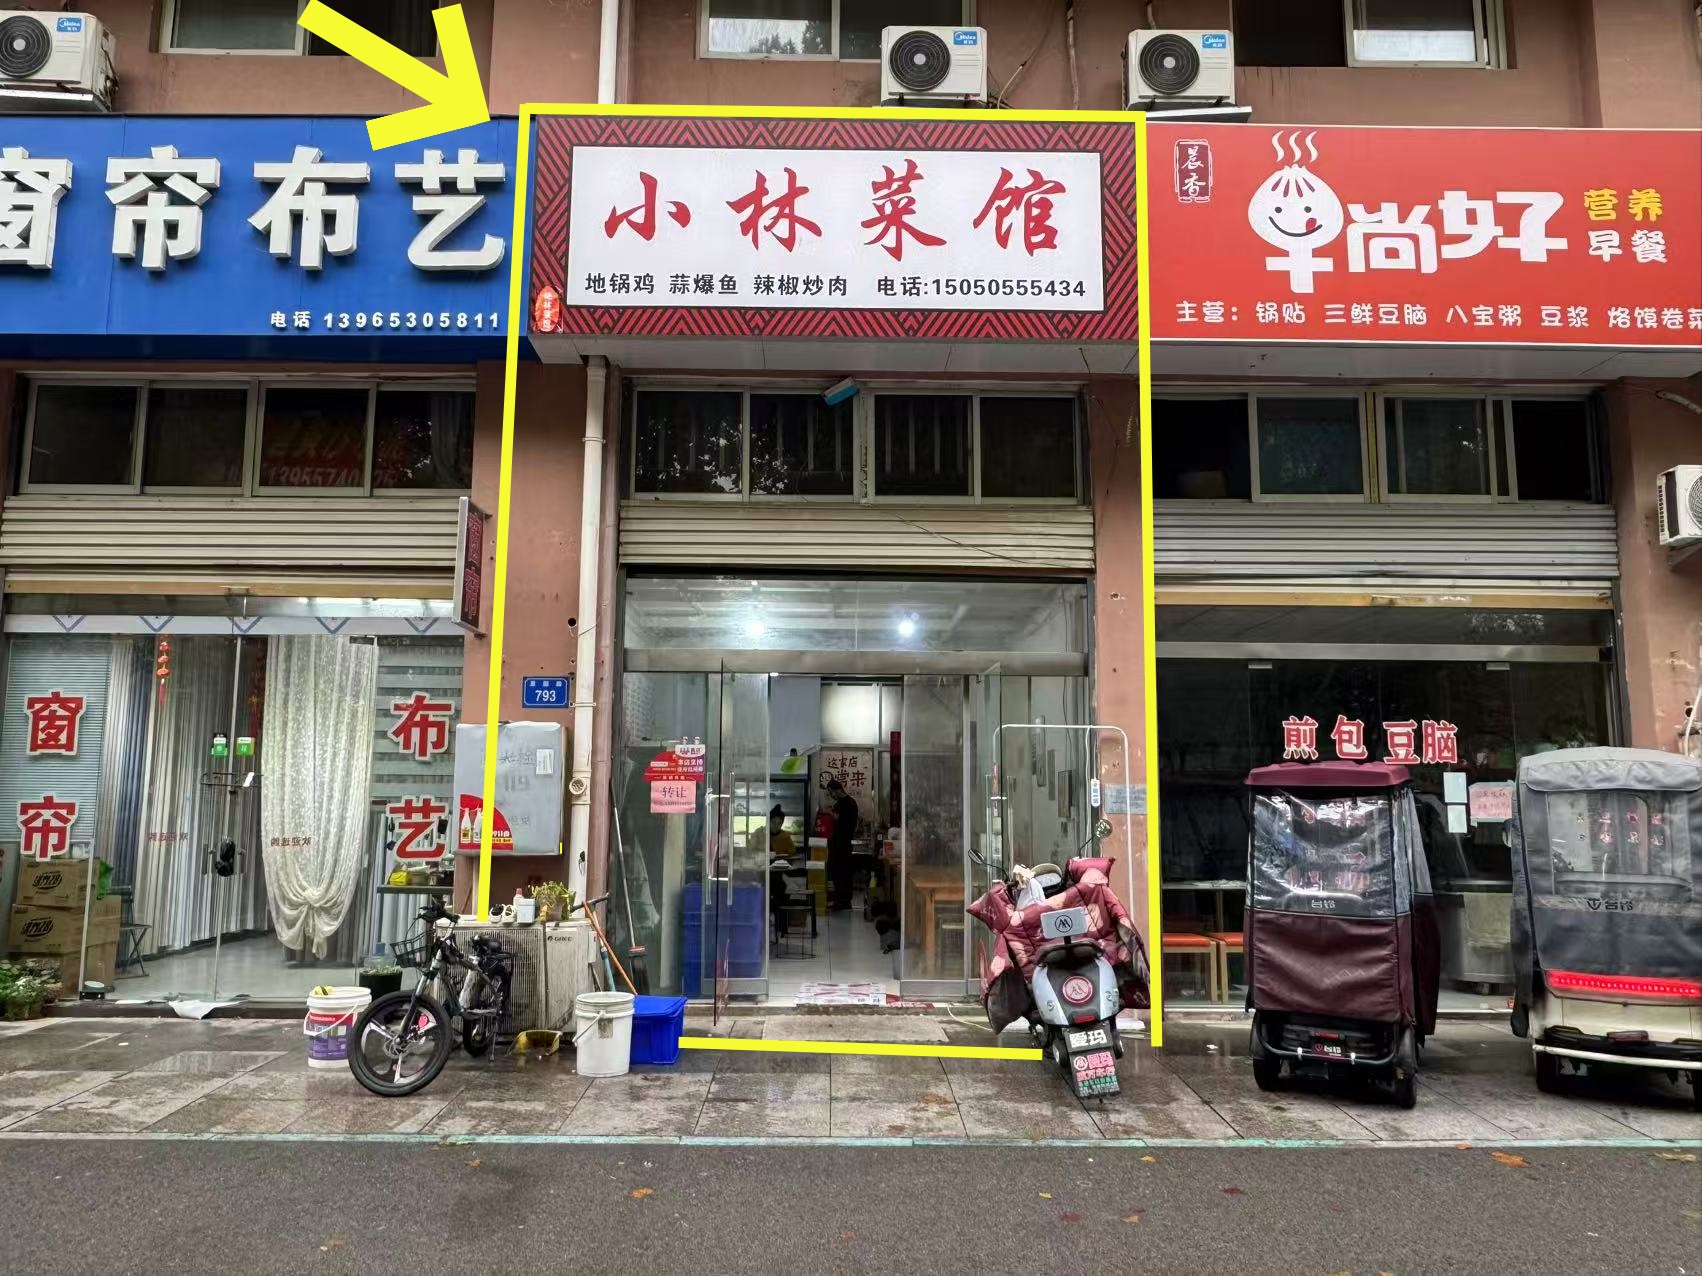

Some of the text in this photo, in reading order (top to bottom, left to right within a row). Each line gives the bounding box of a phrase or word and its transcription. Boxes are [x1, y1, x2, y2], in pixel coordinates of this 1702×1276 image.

[1181, 146, 1206, 197] 晨香
[0, 145, 506, 272] 窗帘布艺
[604, 159, 1067, 262] 小林菜馆
[1584, 188, 1663, 222] 营养
[1588, 229, 1667, 264] 早餐
[585, 273, 655, 295] 地锅鸡
[669, 274, 739, 295] 蒜爆鱼
[753, 274, 847, 296] 辣椒炒肉
[271, 311, 499, 329] 电话 13965305811
[1255, 302, 1306, 324] 锅贴
[1324, 303, 1427, 325] 三鲜豆脑
[1445, 305, 1522, 327] 八宝粥
[1541, 306, 1589, 328] 豆浆
[535, 690, 556, 702] 793
[662, 786, 687, 798] 转让
